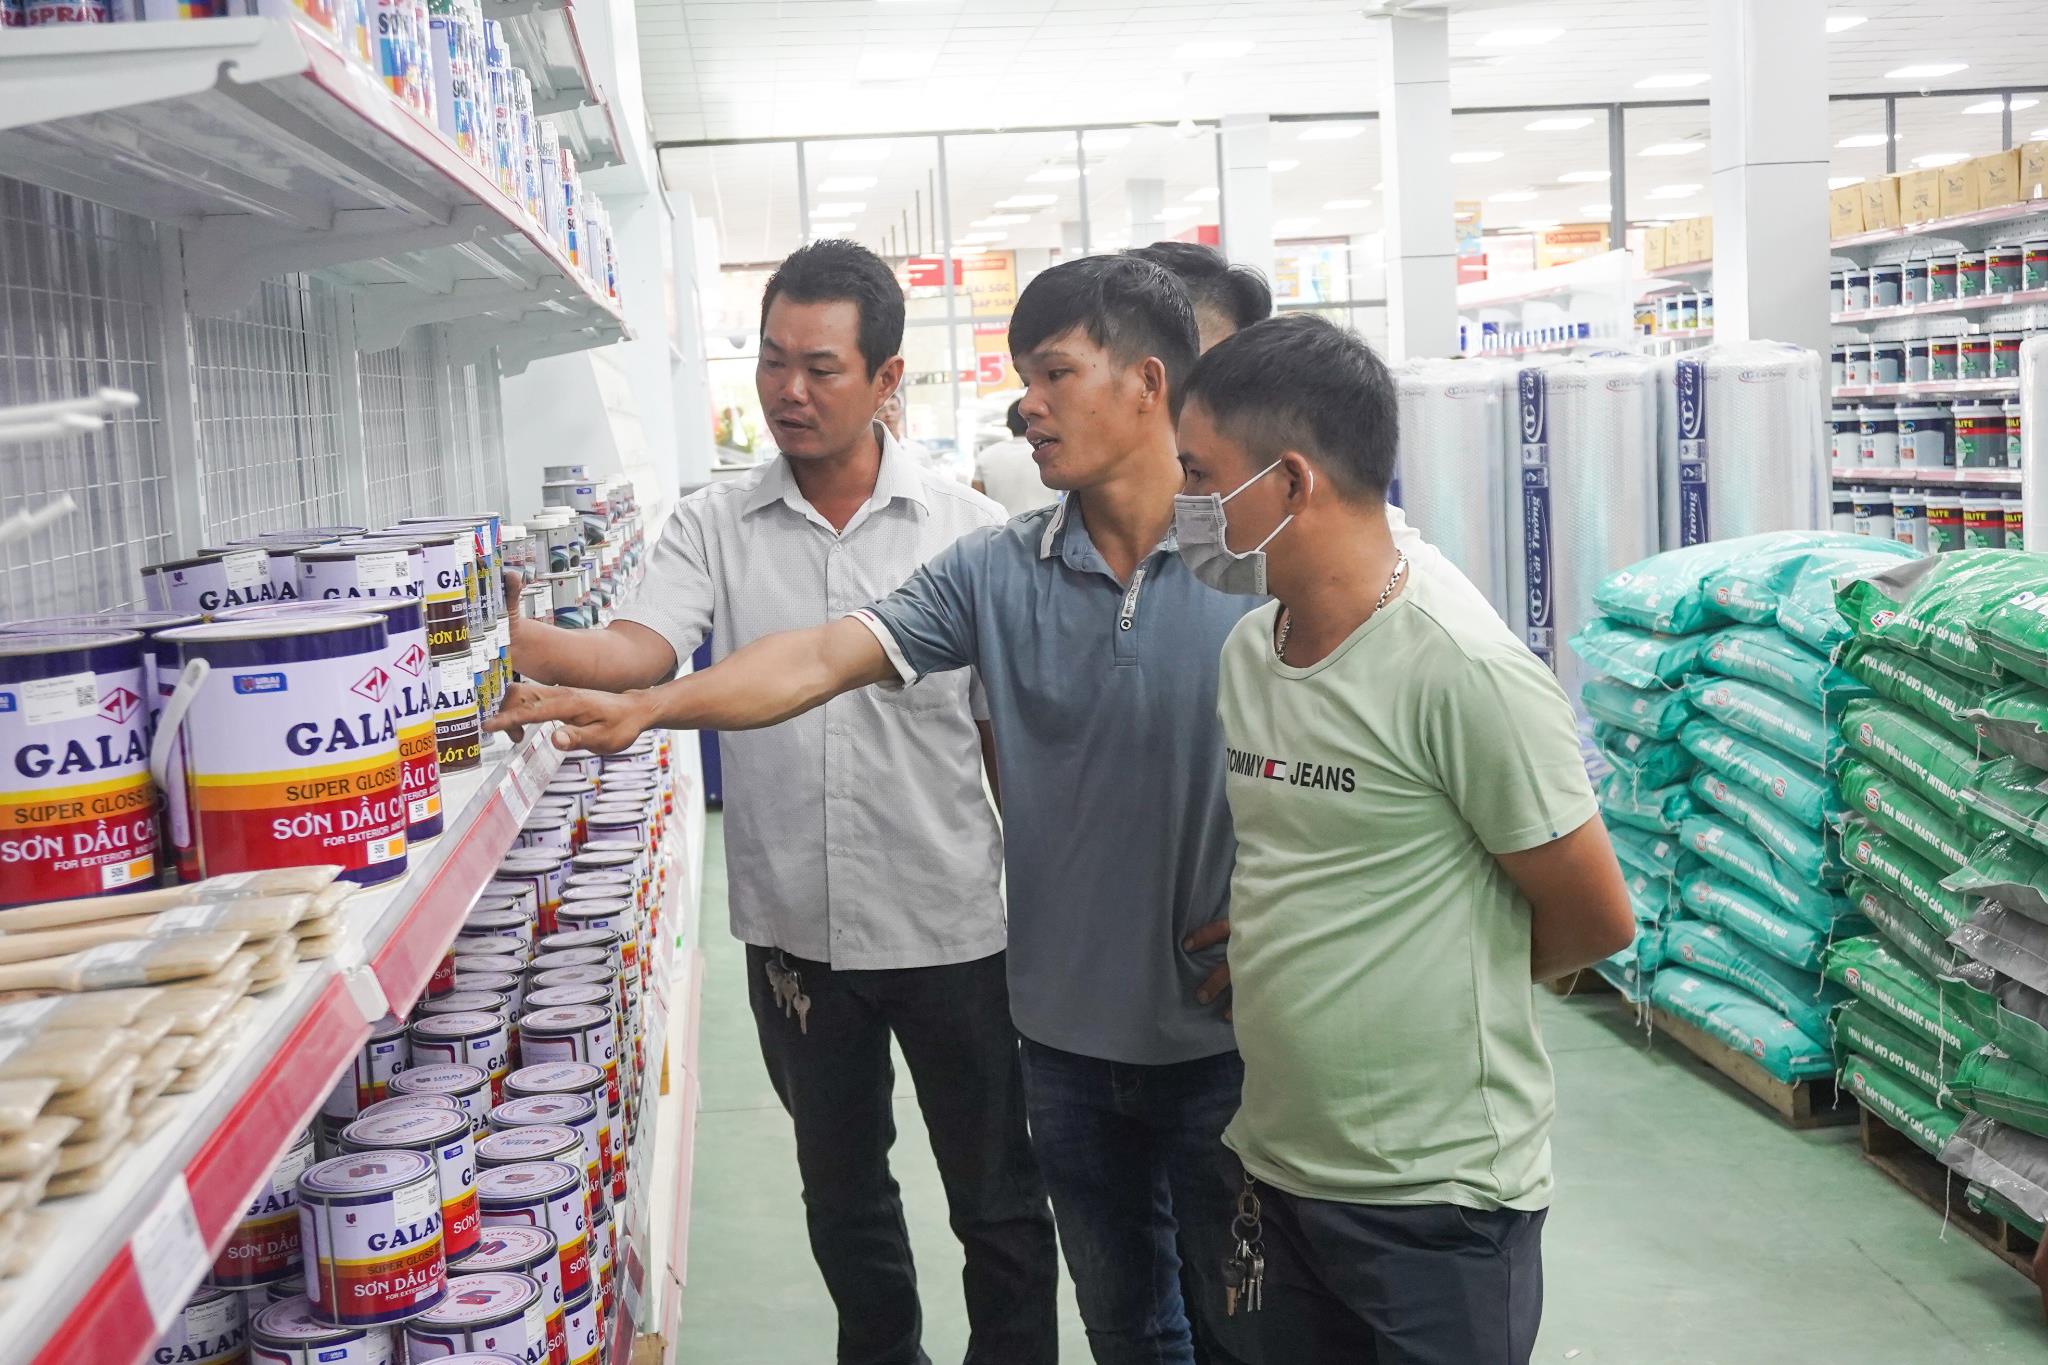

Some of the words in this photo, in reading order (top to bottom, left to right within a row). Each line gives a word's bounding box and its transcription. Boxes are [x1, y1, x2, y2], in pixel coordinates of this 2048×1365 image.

[29, 6, 107, 25] SPRAY
[979, 355, 1003, 382] 5
[200, 581, 277, 611] GALA
[1226, 747, 1264, 778] TOMMY
[1290, 761, 1356, 793] JEANS
[1873, 735, 1885, 751] TOA
[1885, 743, 1902, 763] WALL
[1902, 756, 1928, 781] MASTIC
[286, 778, 350, 801] SUPER
[356, 766, 397, 791] GLOSS
[15, 802, 84, 824] SUPER
[92, 789, 143, 815] GLOSS
[272, 811, 333, 840] SƠN
[340, 796, 387, 831] DẦU
[323, 836, 346, 847] FOR
[347, 826, 390, 841] EXTERIOR
[1881, 800, 1894, 818] TOA
[1895, 810, 1913, 830] WALL
[1914, 823, 1941, 849] MASTIC
[1, 835, 65, 863] SƠN
[73, 820, 129, 855] DẦU
[53, 860, 79, 871] FOR
[81, 849, 132, 868] EXTERIOR
[1900, 873, 1912, 891] TOA
[1913, 884, 1928, 903] CAO
[1862, 980, 1876, 997] TOA
[1876, 989, 1896, 1010] WALL
[1896, 1002, 1923, 1027] MASTIC
[1924, 1018, 1962, 1051] INTERIOR
[1889, 1053, 1904, 1069] CAO
[1904, 1061, 1921, 1080] TOA
[1895, 1106, 1909, 1124] TOA
[1910, 1117, 1924, 1135] CAO
[227, 1244, 262, 1259] SƠN
[267, 1233, 298, 1254] DẦU
[354, 1280, 389, 1297] SƠN
[395, 1268, 427, 1292] DẦU
[367, 1261, 403, 1275] SUPER
